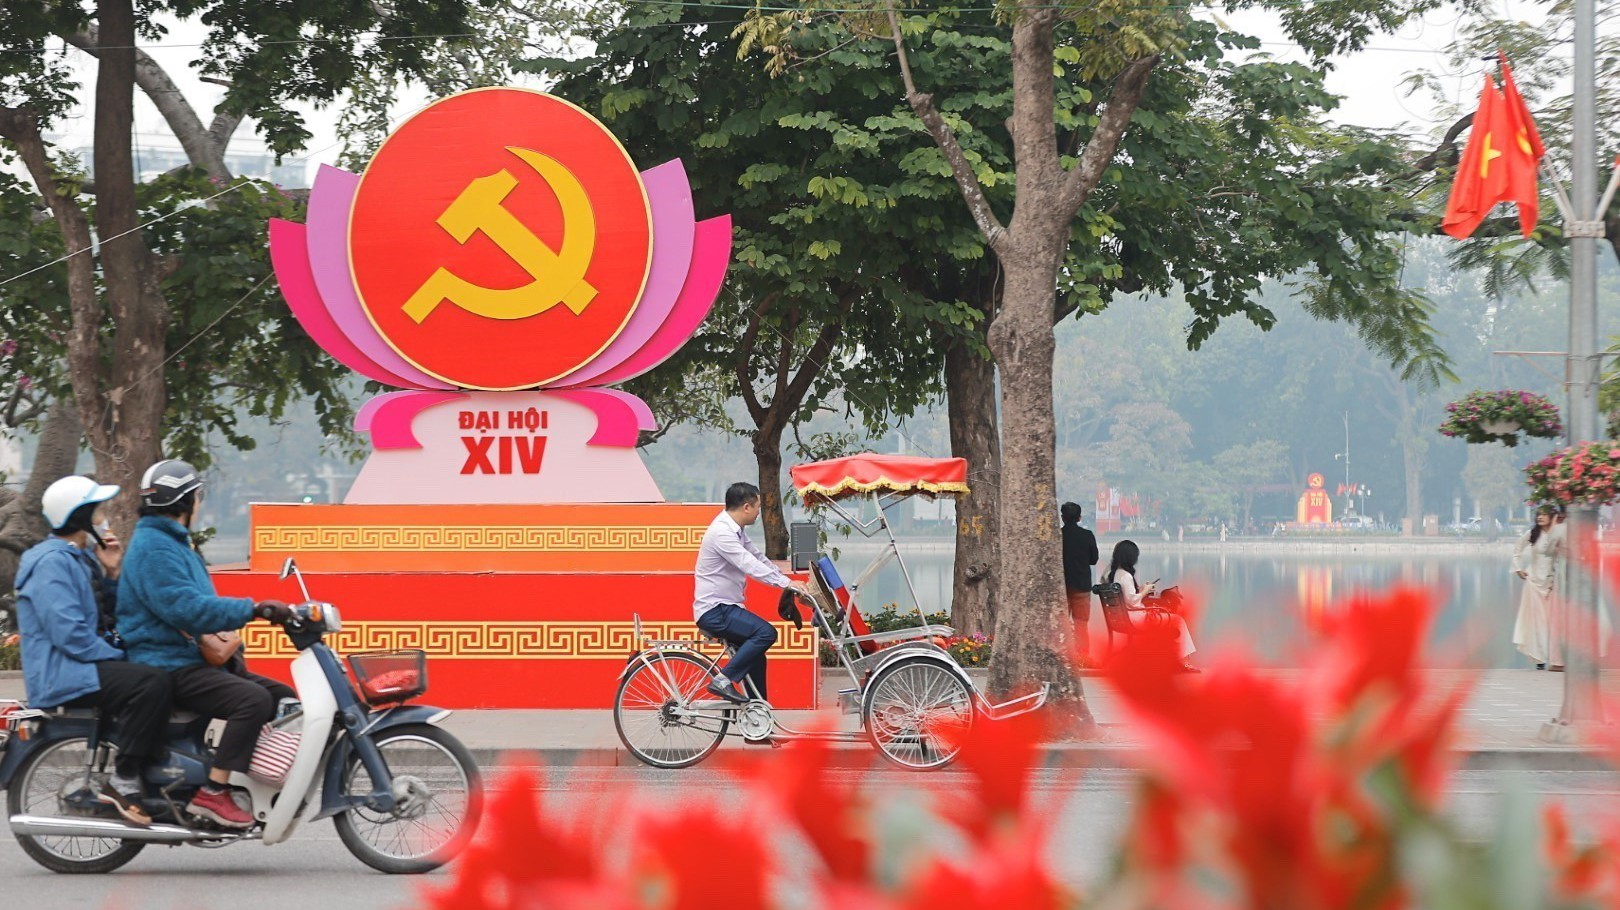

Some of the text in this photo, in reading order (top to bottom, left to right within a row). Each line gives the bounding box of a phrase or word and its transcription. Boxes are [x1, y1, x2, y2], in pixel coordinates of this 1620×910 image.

[458, 407, 548, 433] ĐẠI HỘI
[460, 436, 547, 474] XIV
